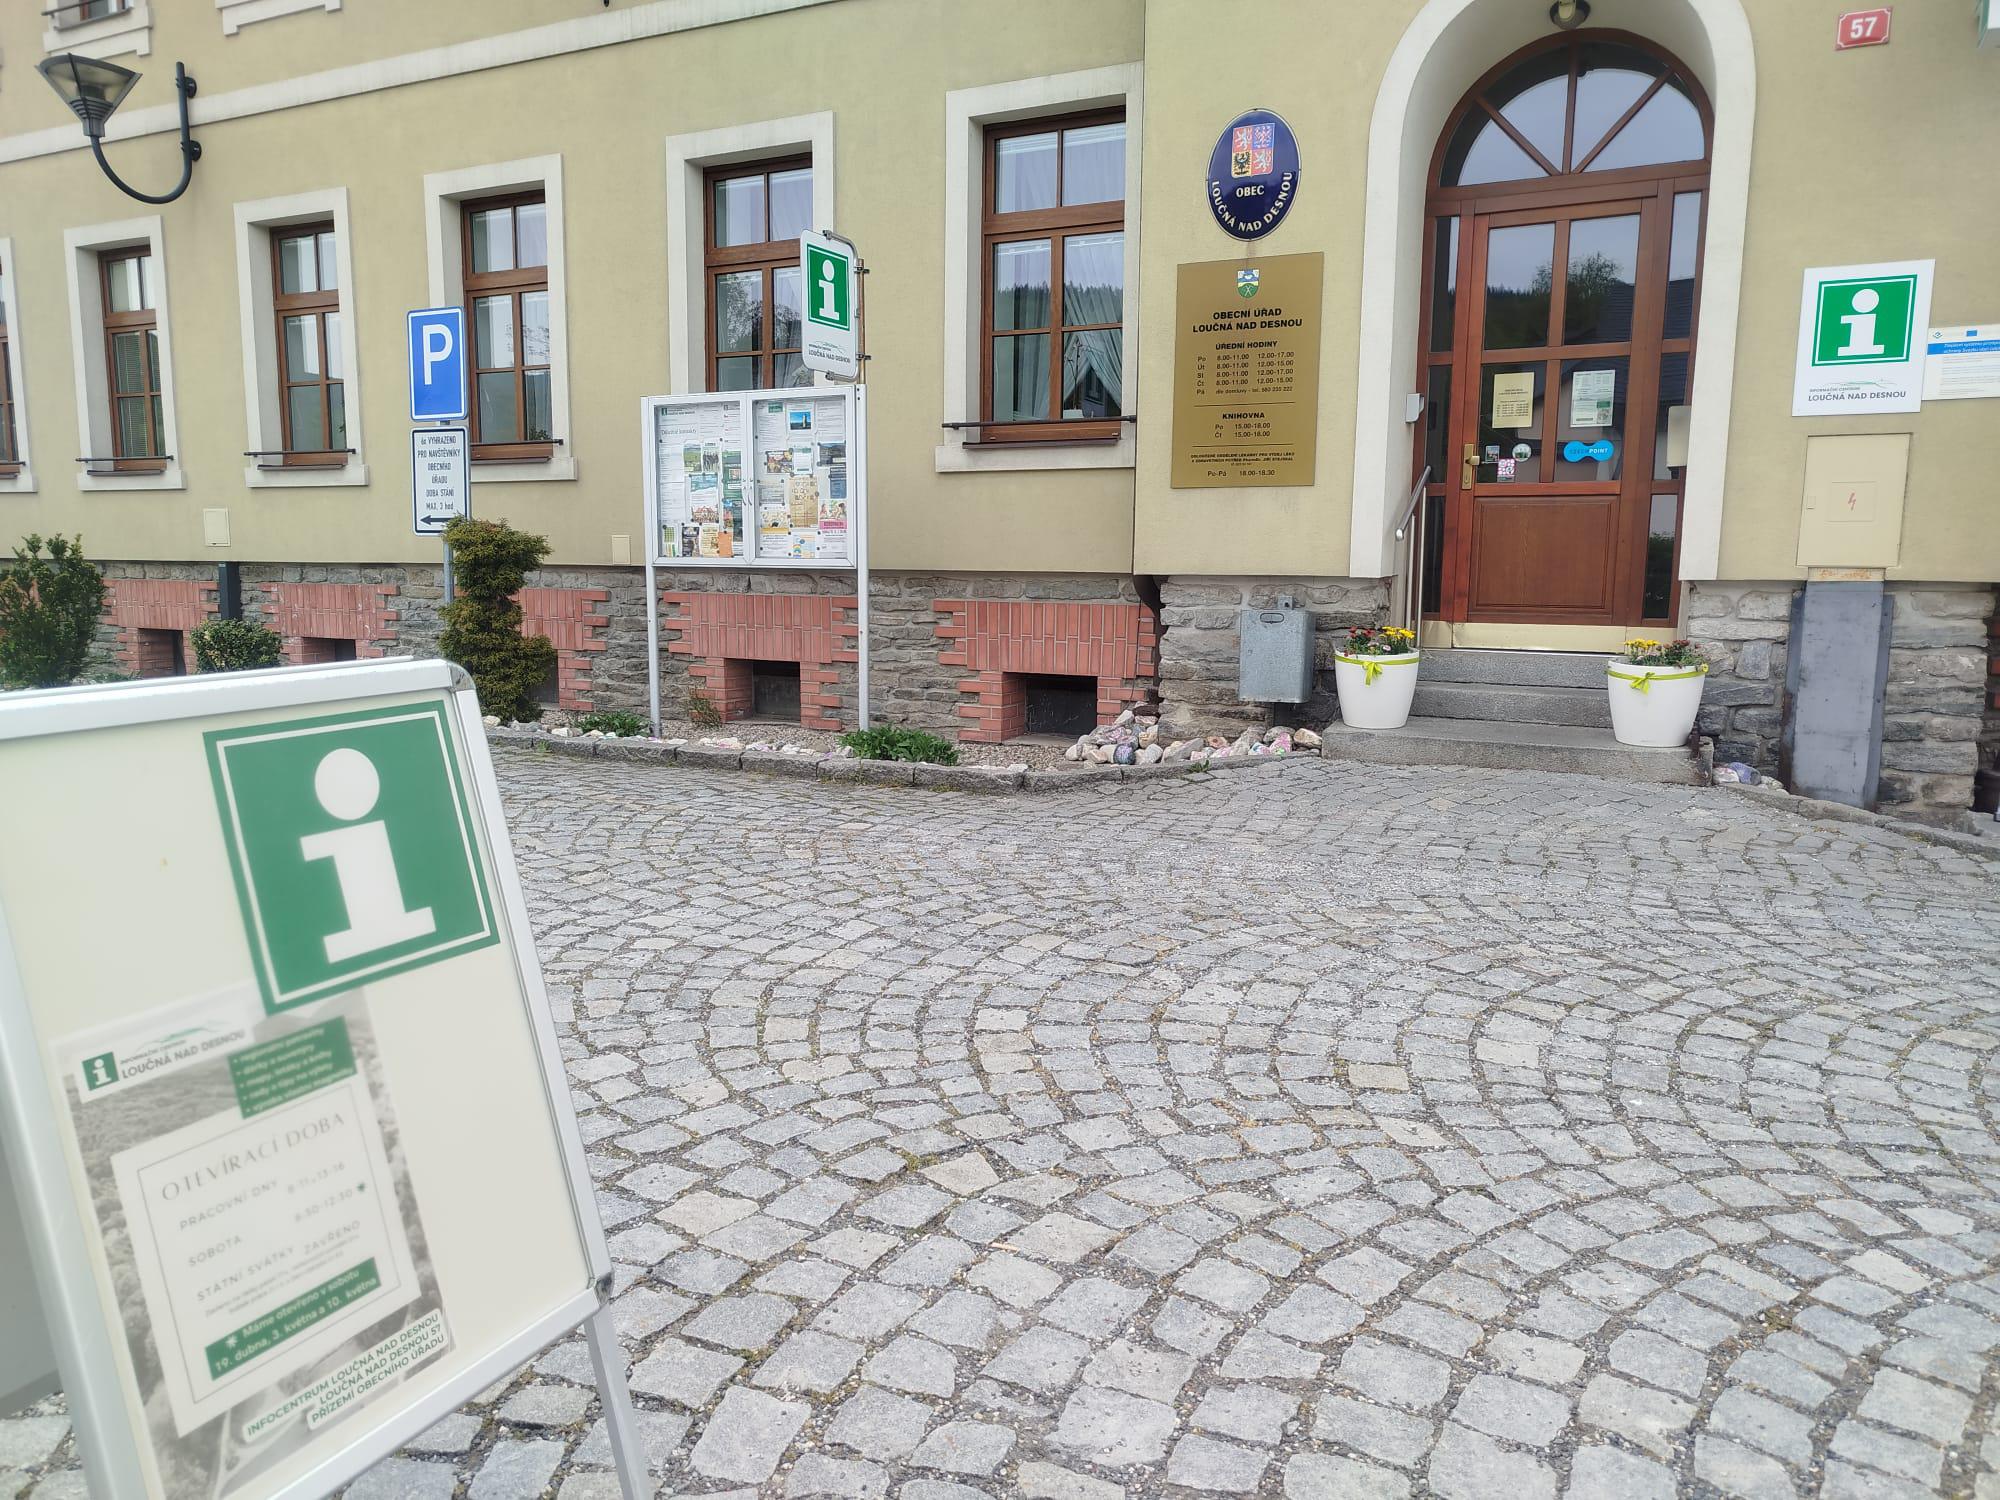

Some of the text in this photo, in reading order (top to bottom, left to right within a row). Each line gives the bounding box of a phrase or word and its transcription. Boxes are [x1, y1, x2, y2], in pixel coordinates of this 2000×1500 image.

[1850, 17, 1877, 39] 57
[1212, 172, 1293, 232] LOUČNÁ NAD DESNOU
[1236, 185, 1264, 198] OBEC
[1192, 318, 1303, 333] LOUČNÁ NAD DESNOU
[1213, 307, 1282, 320] OBECNÍ ÚŘAD
[422, 324, 454, 385] P
[1215, 340, 1278, 350] ÚŘEDNÍ HODINY
[1808, 392, 1845, 402] LOUČNÁ
[1870, 391, 1906, 399] DESNOU
[1222, 412, 1265, 420] KNIHOVNA
[418, 447, 460, 458] PRO NAVŠTĚVNÍKY
[428, 436, 456, 444] VYHRAZENO
[426, 486, 454, 498] DOBA STÁNÍ
[445, 501, 454, 510] hod
[121, 1029, 246, 1079] LOUČNÁ NAD DESNOU
[285, 1113, 344, 1148] DOBA
[179, 1180, 278, 1231] PRACOVNÍ DNY
[188, 1235, 242, 1268] SOBOTA
[242, 1269, 360, 1338] Máme otevřeno v sobotu
[215, 1276, 377, 1372] 19. dubna, 3. května a 10. května
[247, 1314, 440, 1436] INFOCENTRUM LOUČNÁ NAD DESNOU
[320, 1324, 442, 1405] LOUČNÁ NAD DESNOU 57
[311, 1334, 446, 1424] PŘÍZEMÍ OBECNÍHO ÚŘADU
